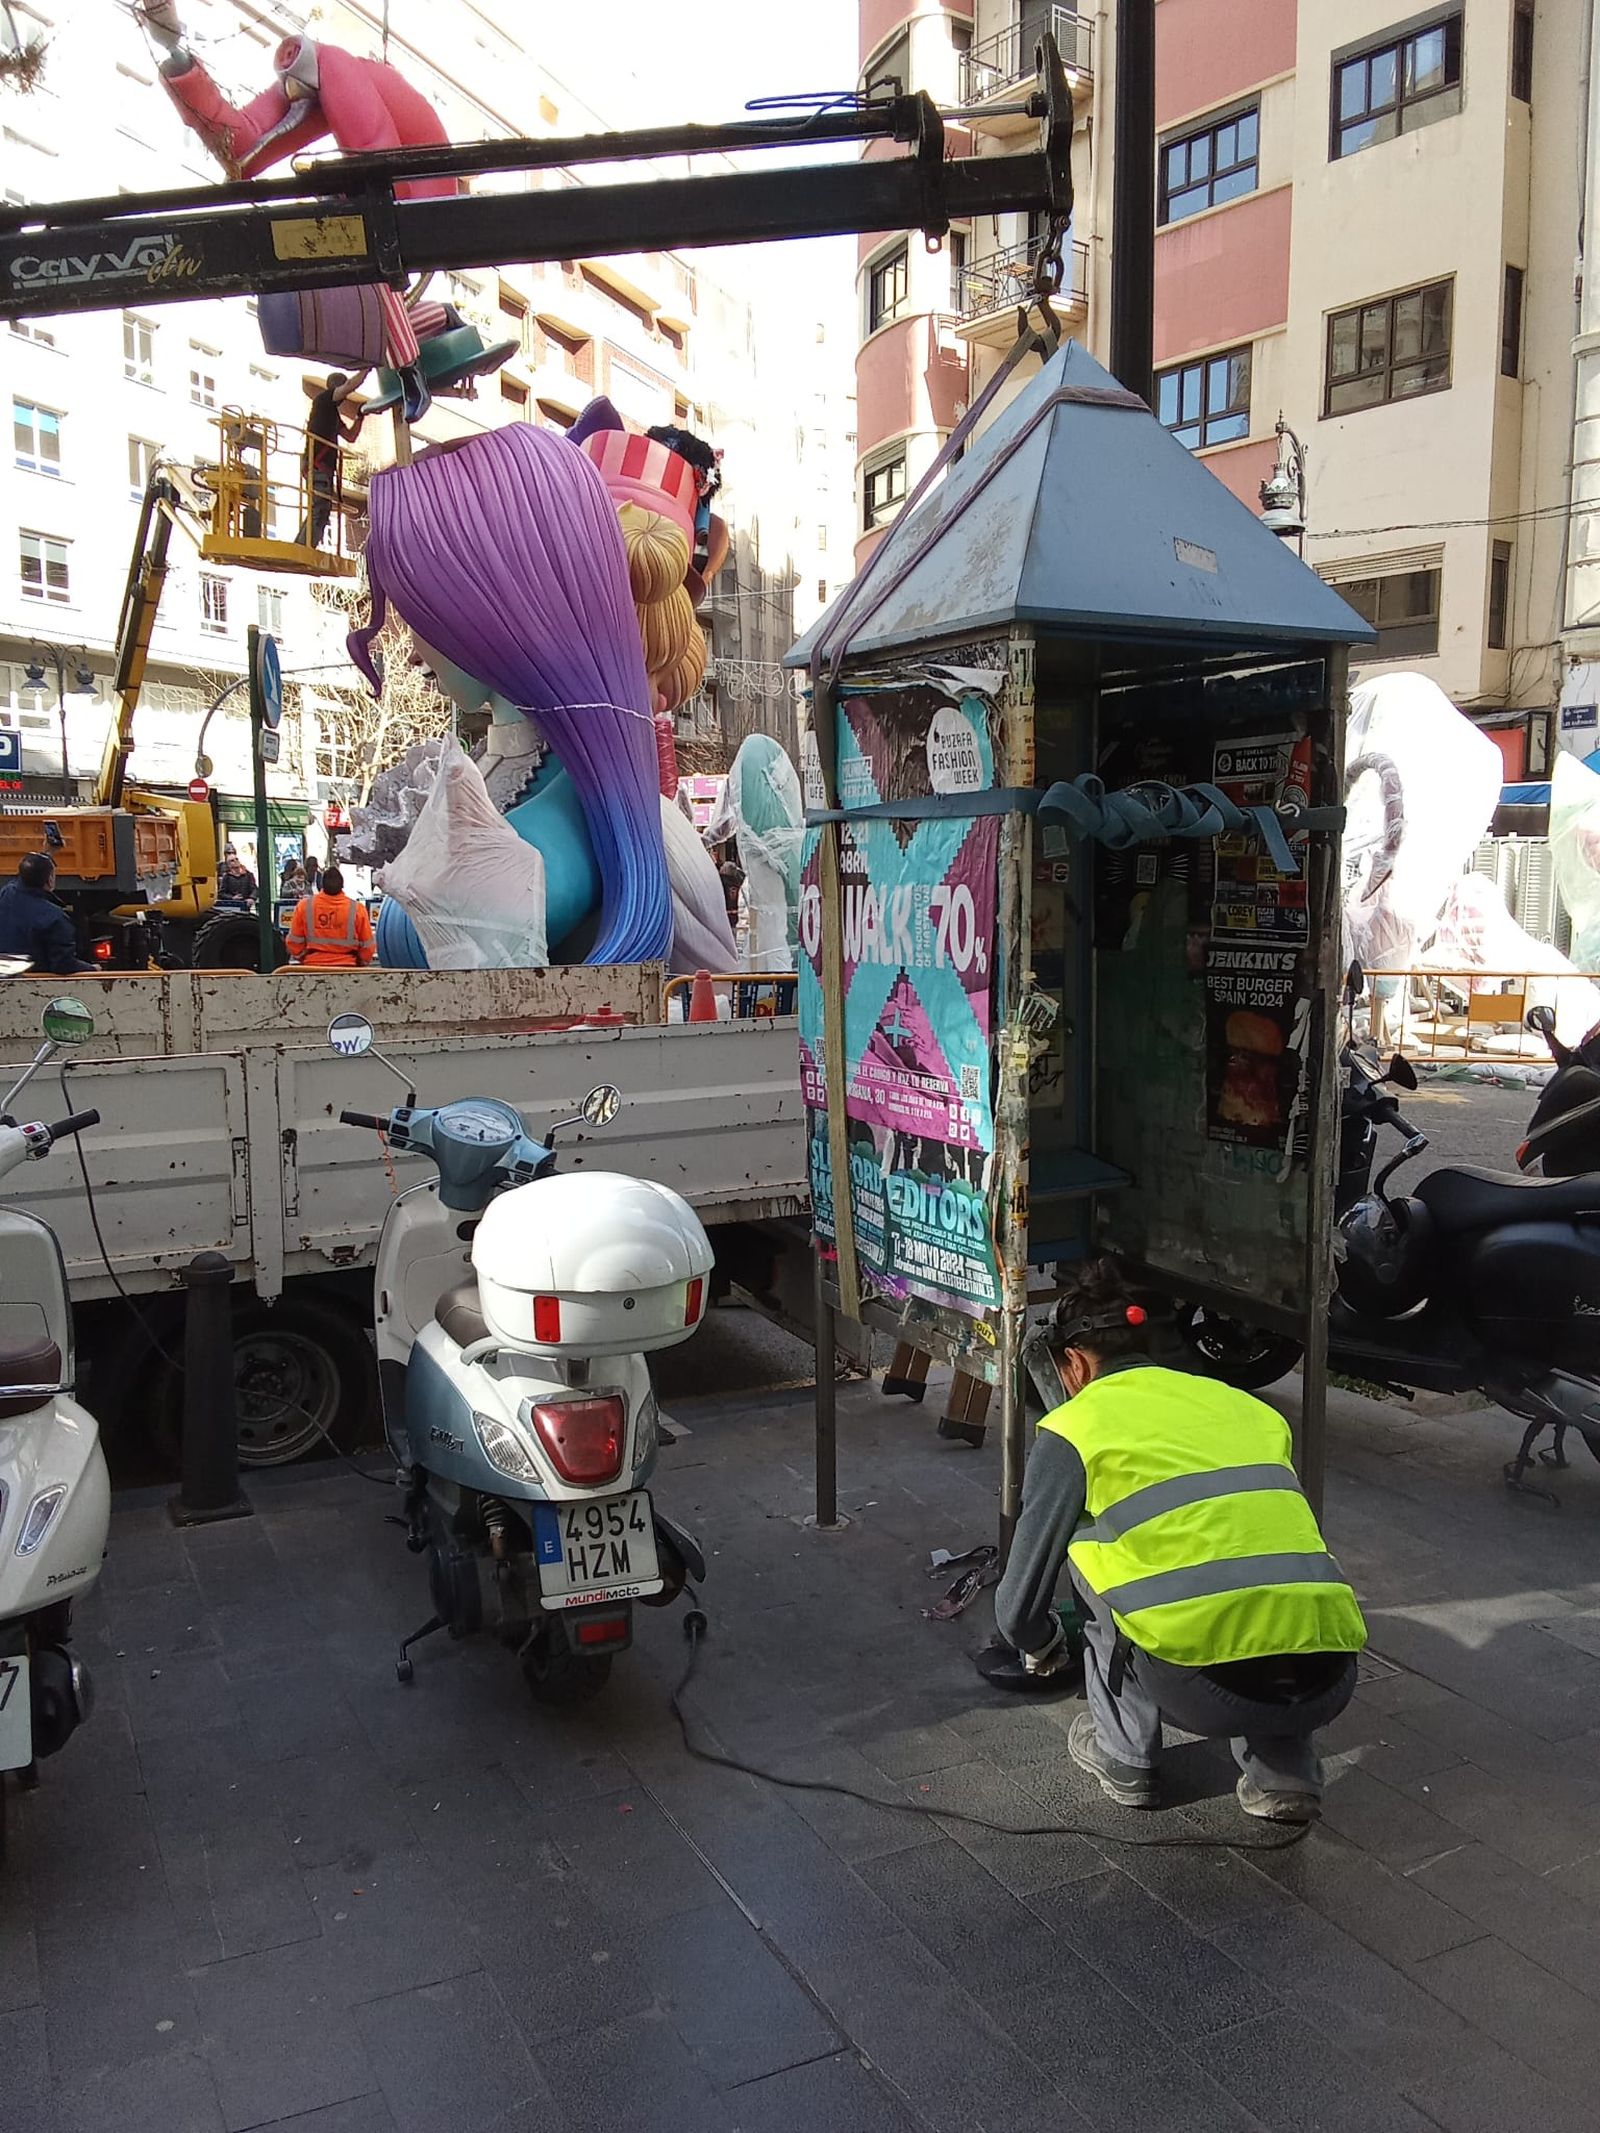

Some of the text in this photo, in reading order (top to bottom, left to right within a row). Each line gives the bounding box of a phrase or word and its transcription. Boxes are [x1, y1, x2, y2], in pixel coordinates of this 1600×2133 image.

[932, 750, 976, 770] FASHION
[1235, 757, 1258, 772] BACK
[954, 769, 979, 785] WEEK
[841, 884, 914, 967] WALK
[1206, 951, 1298, 971] JENKIN'S
[1206, 975, 1294, 994] BEST BURGER
[1213, 989, 1285, 1008] SPAIN 2024
[886, 1174, 985, 1241] EDITORS
[914, 1238, 940, 1269] MAYO
[940, 1247, 965, 1277] 2024
[976, 1322, 992, 1339] OUT
[565, 1498, 646, 1542] 4954
[544, 1541, 555, 1554] E
[567, 1539, 632, 1583] HZM
